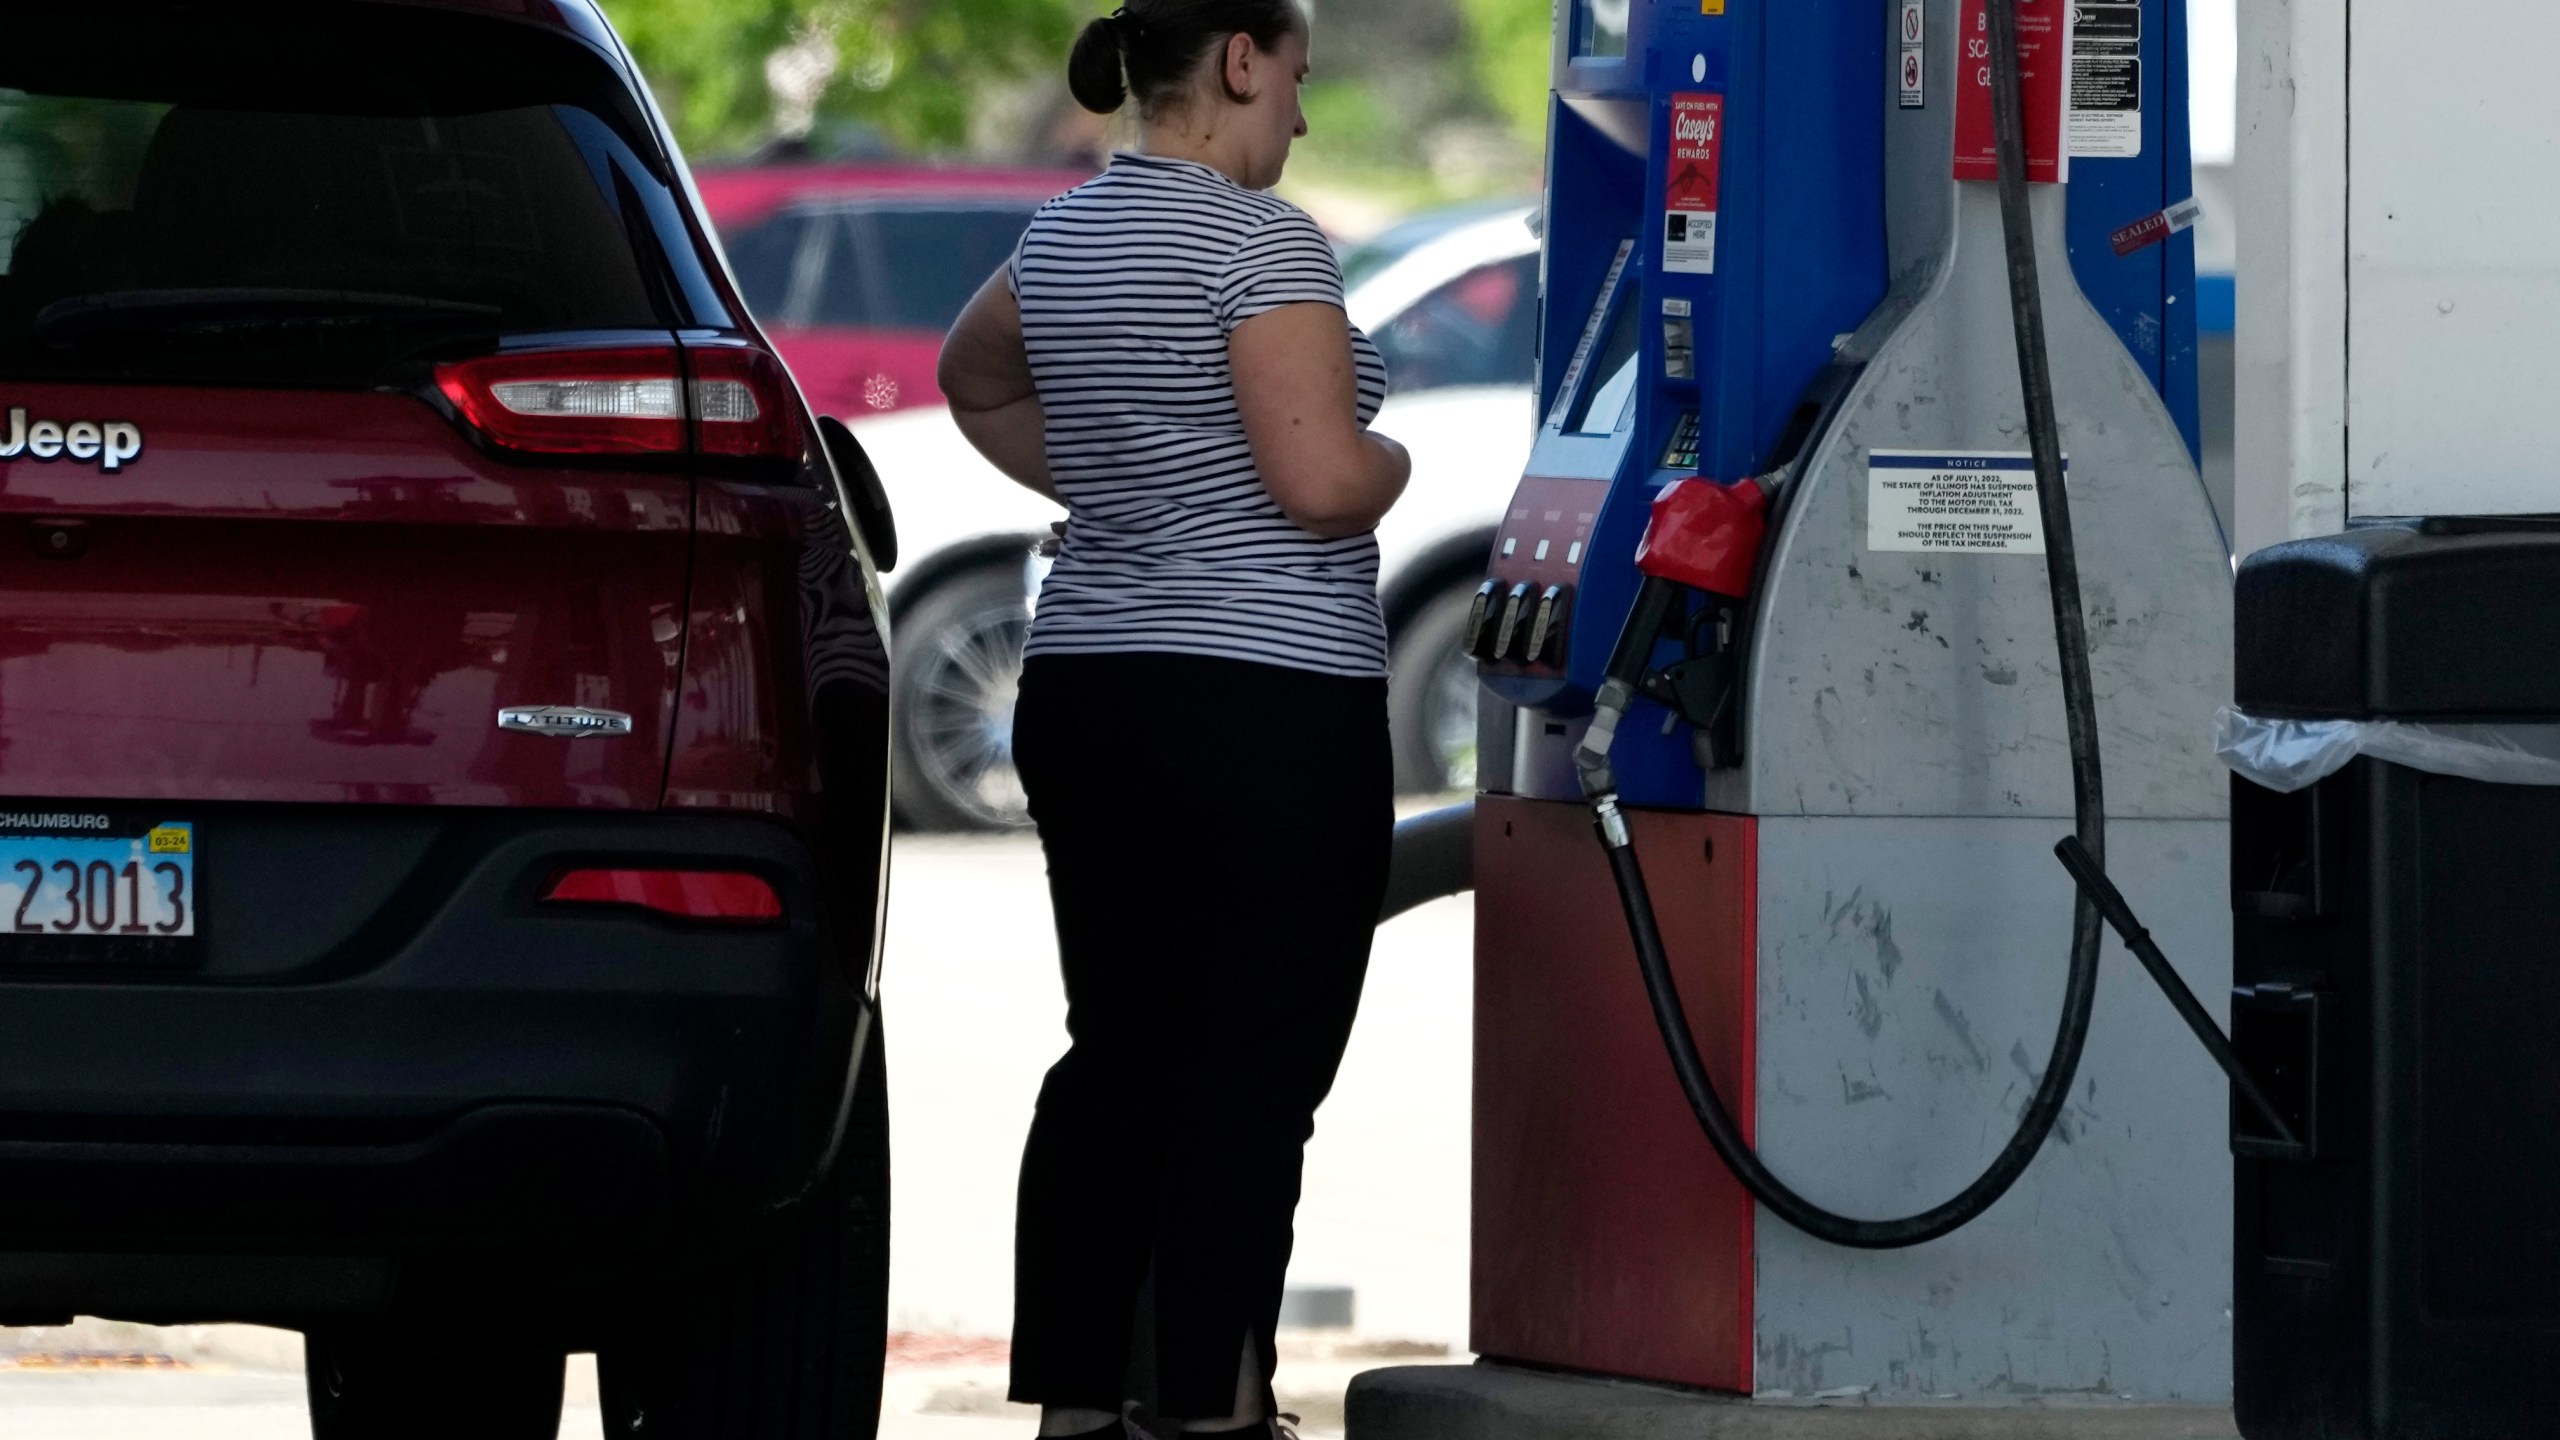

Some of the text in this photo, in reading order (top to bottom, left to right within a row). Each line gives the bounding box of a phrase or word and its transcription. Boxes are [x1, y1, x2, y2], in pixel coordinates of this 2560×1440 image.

[1675, 102, 1686, 110] SAVE
[1687, 102, 1693, 110] ON
[1706, 103, 1718, 111] WITH
[1675, 112, 1715, 147] Casey's
[1677, 148, 1710, 160] REWARDS
[1687, 219, 1712, 229] ACCEPTED
[1693, 229, 1706, 239] HERE
[2111, 215, 2164, 246] SEALED
[0, 408, 141, 468] Jeep
[1947, 460, 1987, 468] NOTICE
[1975, 475, 1980, 483] 1,
[1982, 475, 2002, 483] 2022,
[1992, 508, 2001, 516] 31,
[512, 714, 621, 728] LATITUDE
[154, 836, 186, 847] 03-24
[14, 859, 185, 933] 23013
